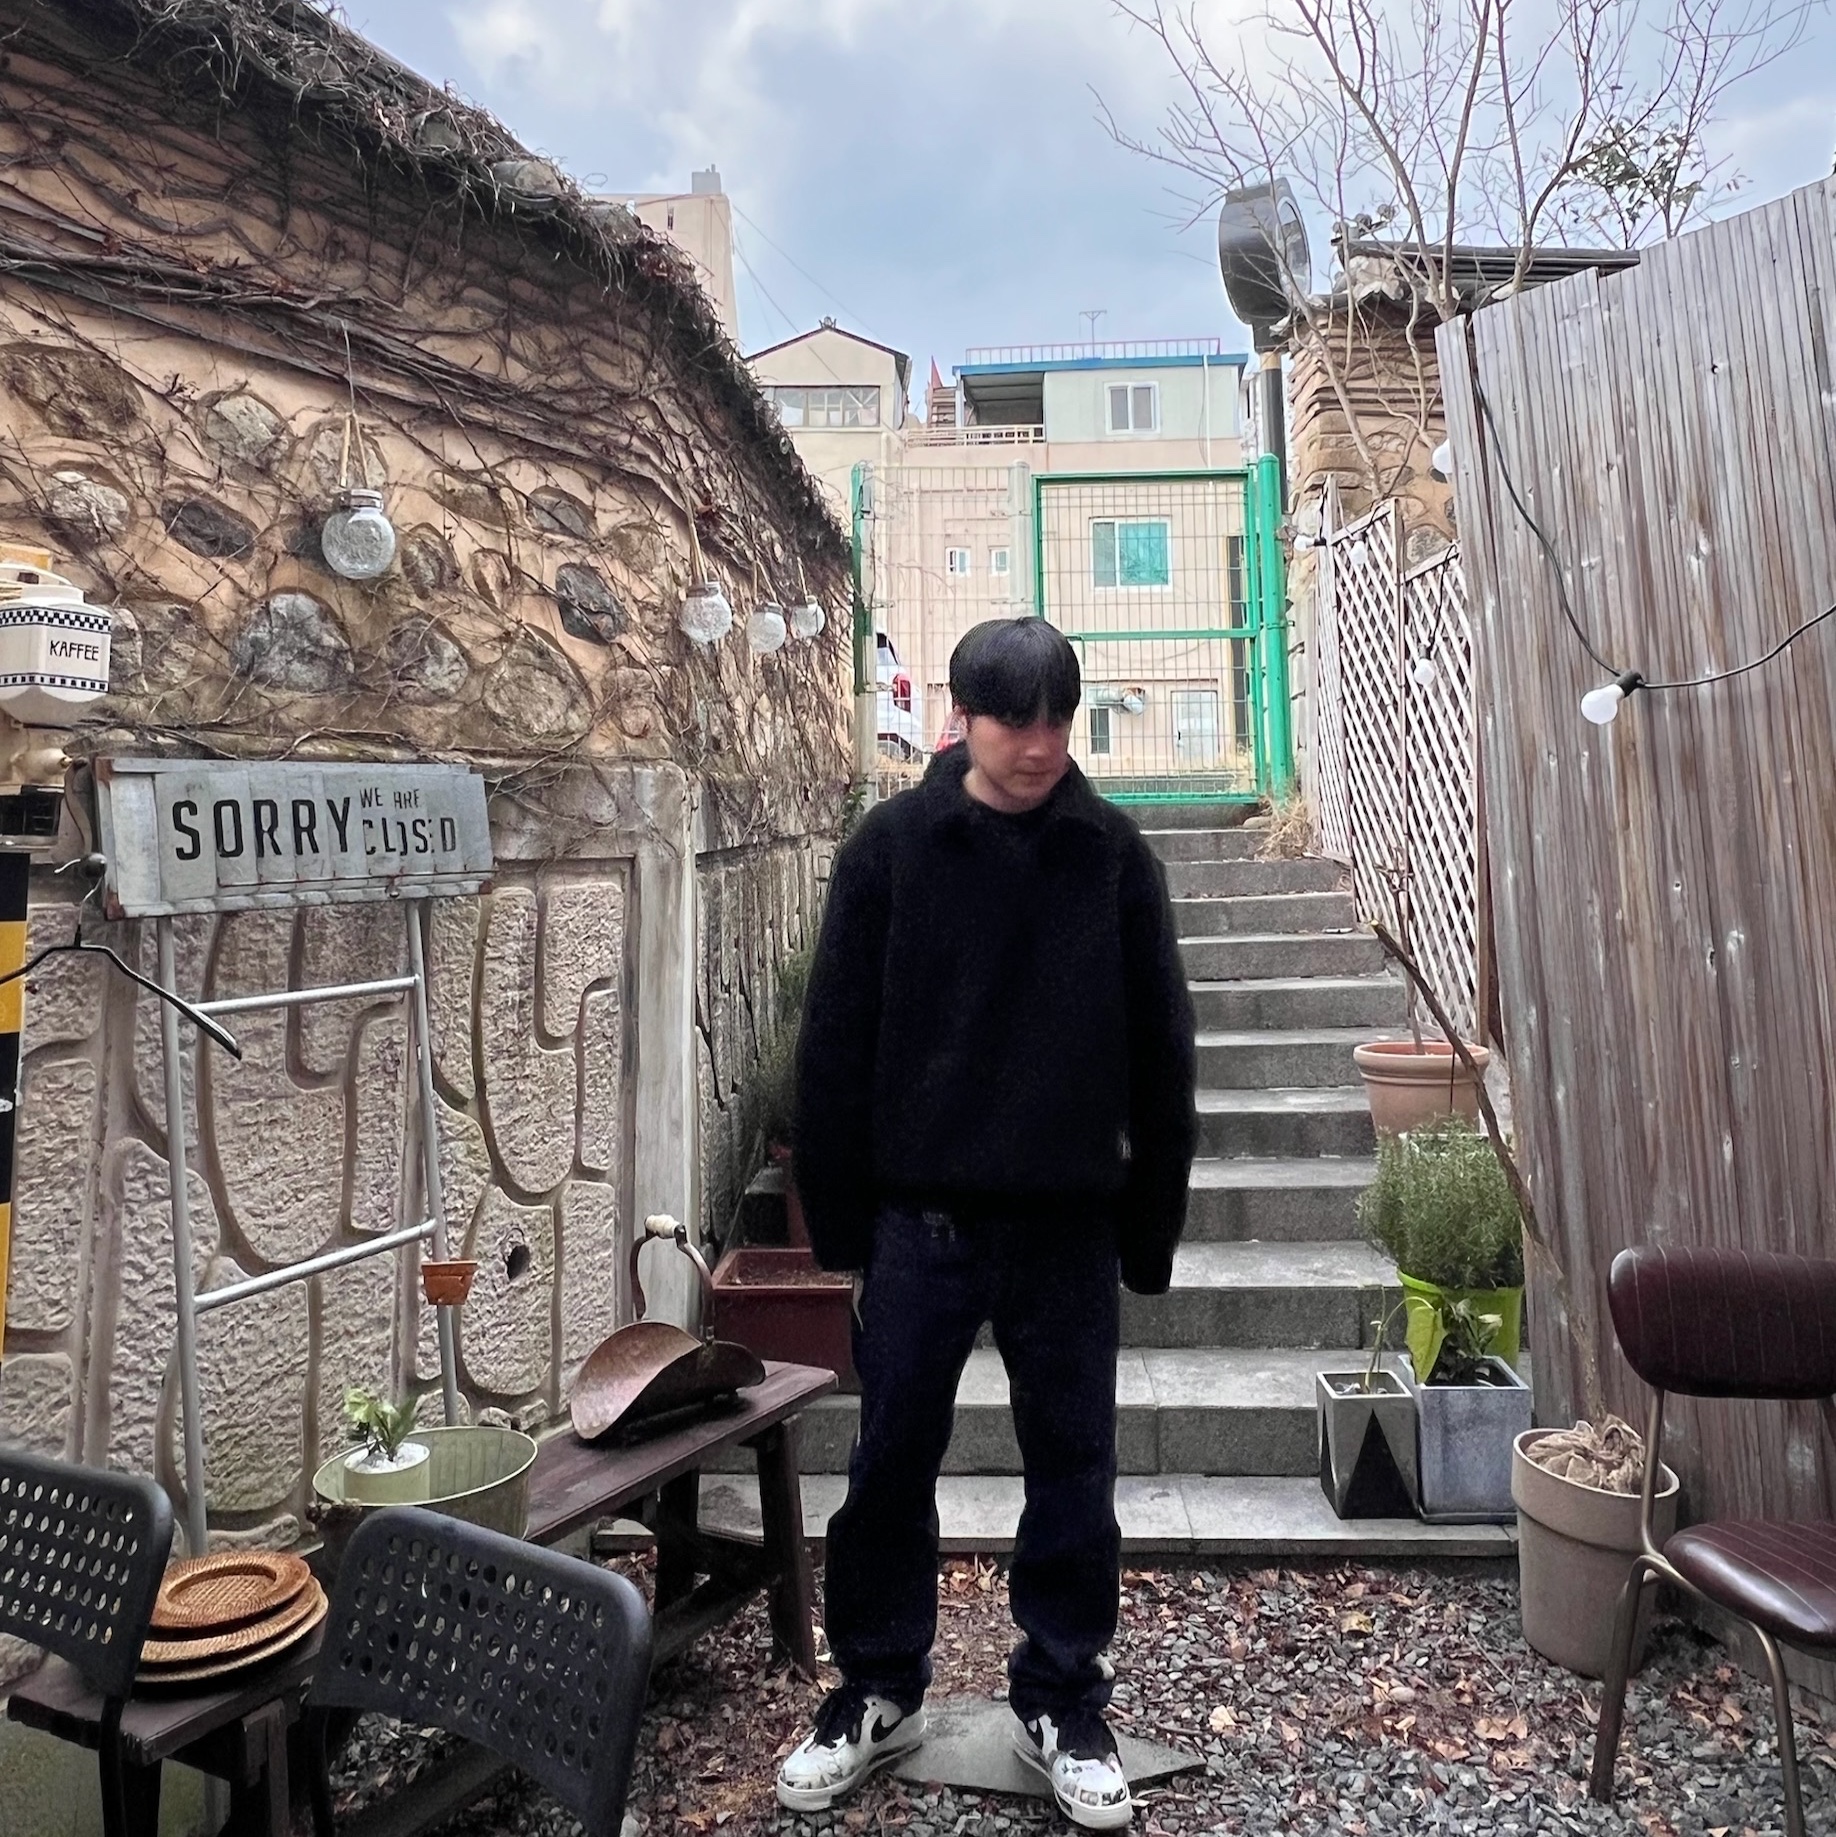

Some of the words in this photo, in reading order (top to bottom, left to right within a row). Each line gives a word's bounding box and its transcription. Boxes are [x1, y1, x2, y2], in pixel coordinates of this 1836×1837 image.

[49, 640, 99, 661] KAFFEE
[360, 787, 383, 808] WE
[394, 788, 420, 809] ARE
[172, 797, 351, 860] SORRY
